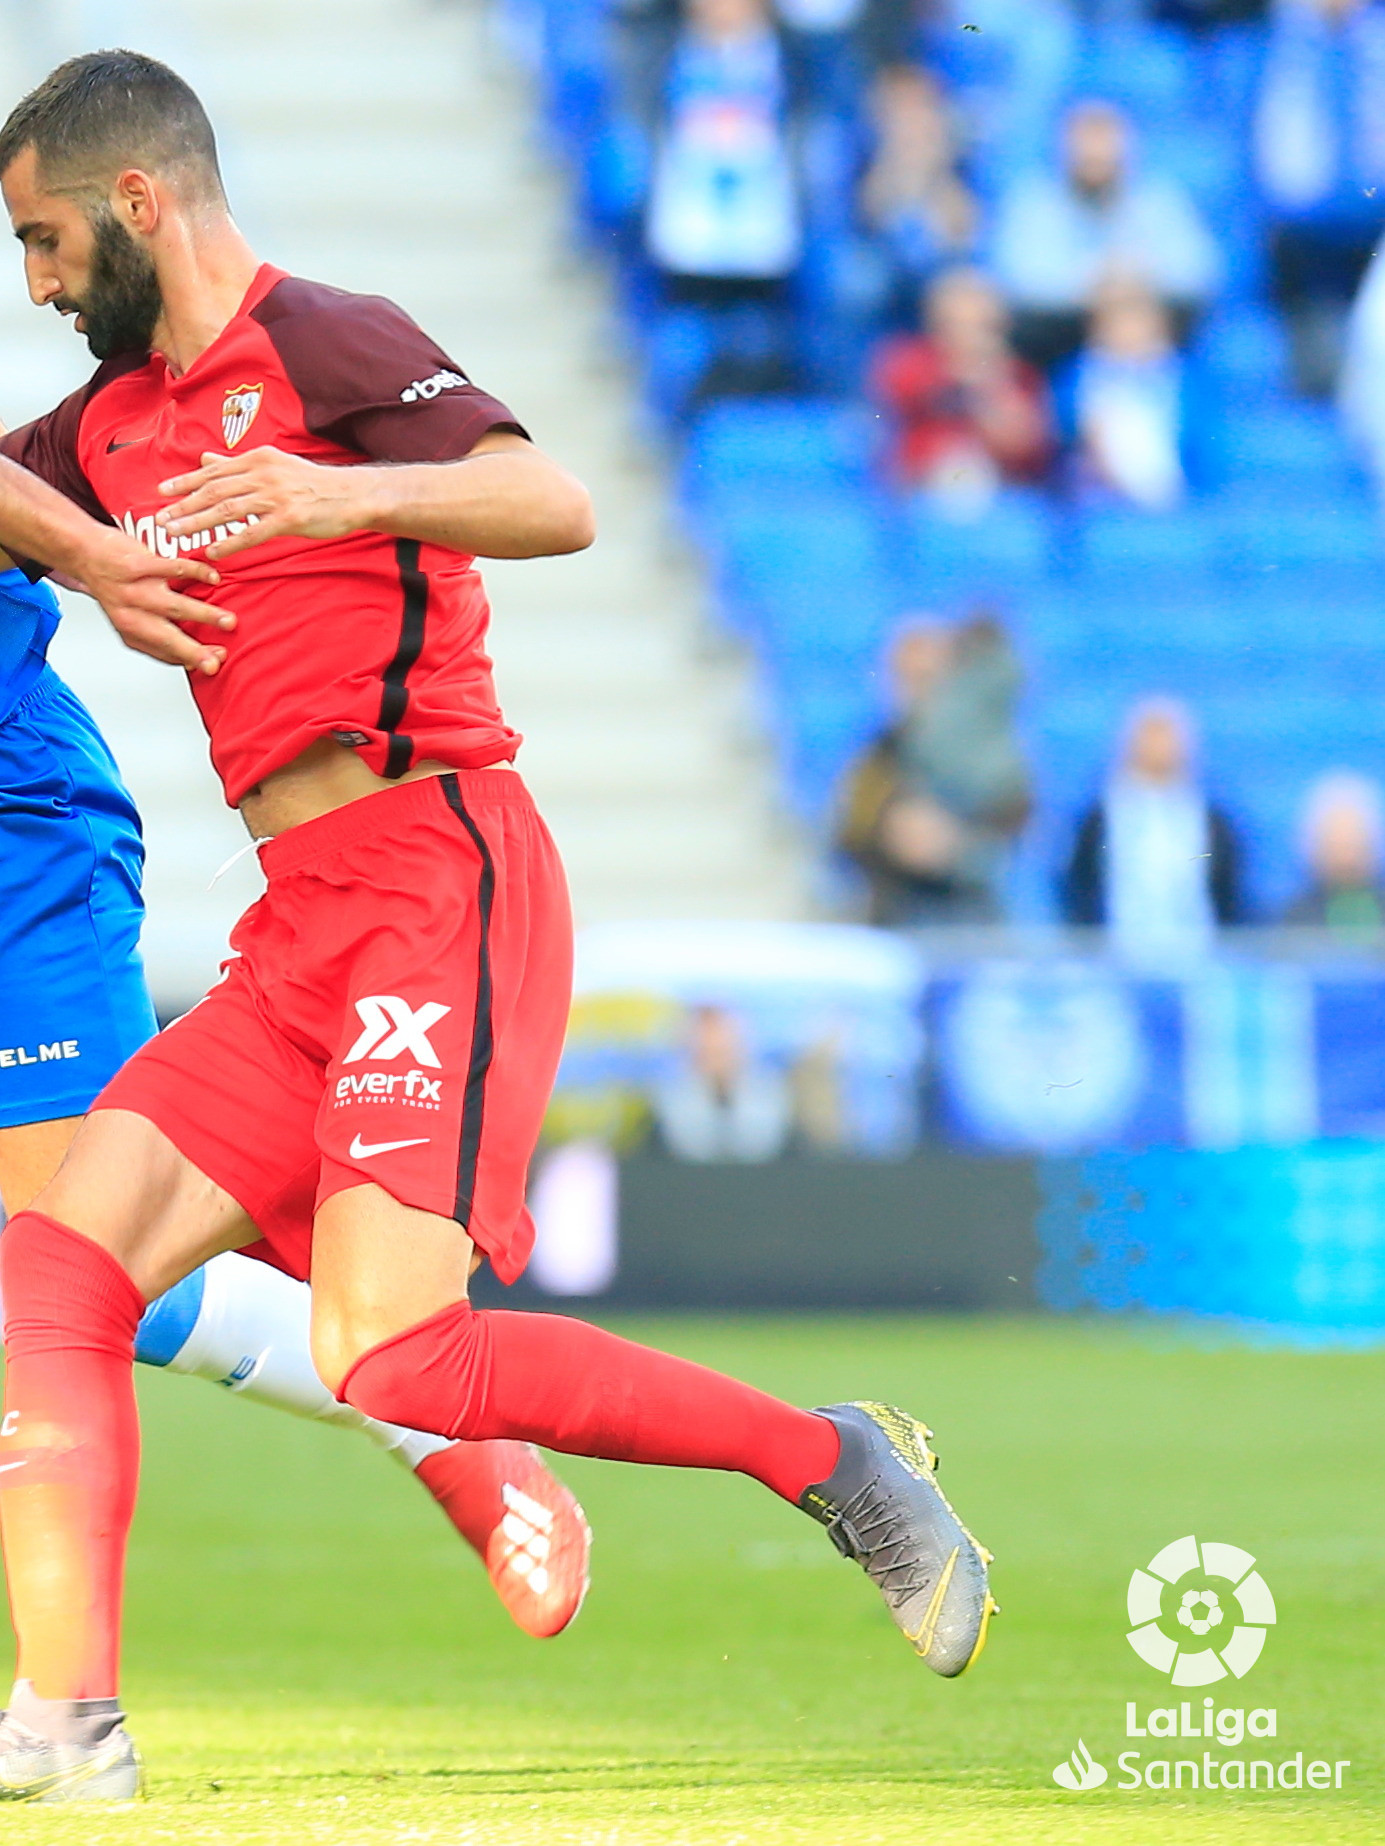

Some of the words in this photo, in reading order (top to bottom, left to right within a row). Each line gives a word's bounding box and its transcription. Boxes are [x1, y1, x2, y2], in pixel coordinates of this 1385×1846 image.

[336, 1070, 443, 1101] everfx
[334, 1098, 352, 1109] FOR
[357, 1096, 395, 1104] EVERY
[401, 1098, 441, 1111] TRADE
